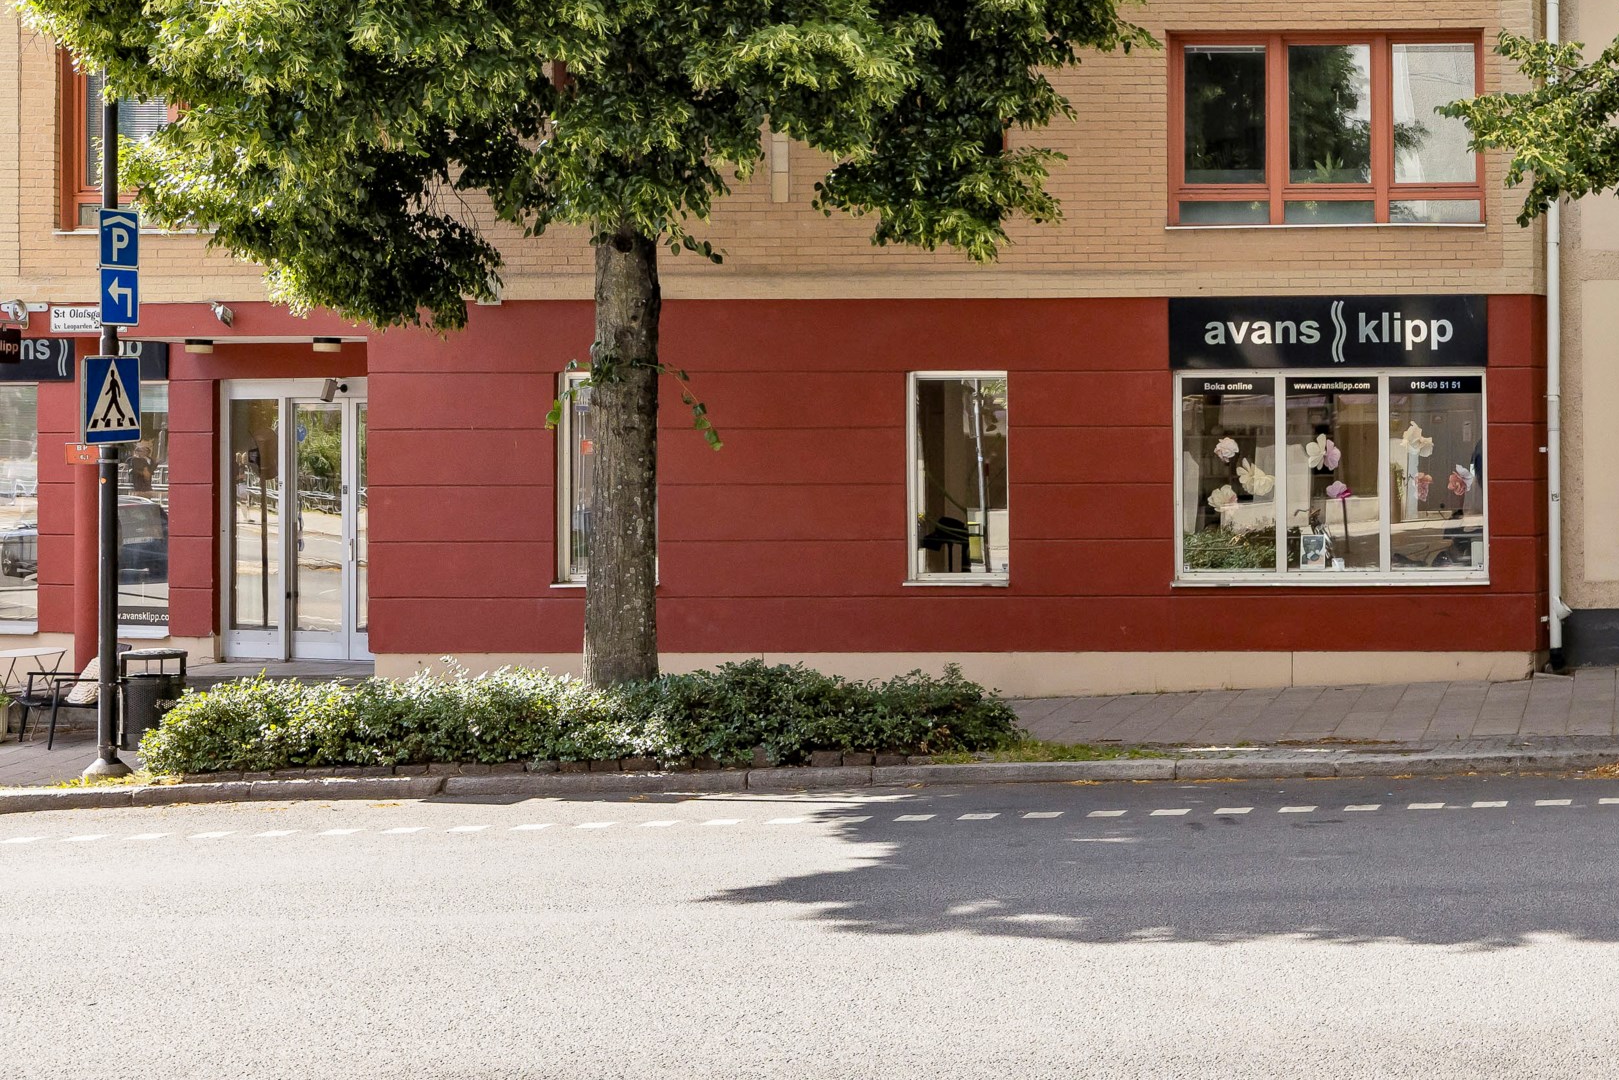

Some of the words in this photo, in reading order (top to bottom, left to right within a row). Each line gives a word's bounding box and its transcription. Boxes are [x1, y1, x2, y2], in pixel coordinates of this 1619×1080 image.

[112, 227, 129, 261] P
[69, 309, 100, 320] Olofsga
[1204, 319, 1321, 344] avans
[1358, 312, 1453, 351] klipp
[0, 340, 19, 355] lipp
[1204, 382, 1226, 390] Boka
[1227, 382, 1253, 390] online
[1294, 382, 1370, 391] www.avansklipp.com
[1410, 381, 1438, 390] 018-69
[1440, 381, 1449, 389] 51
[1451, 381, 1461, 389] 51
